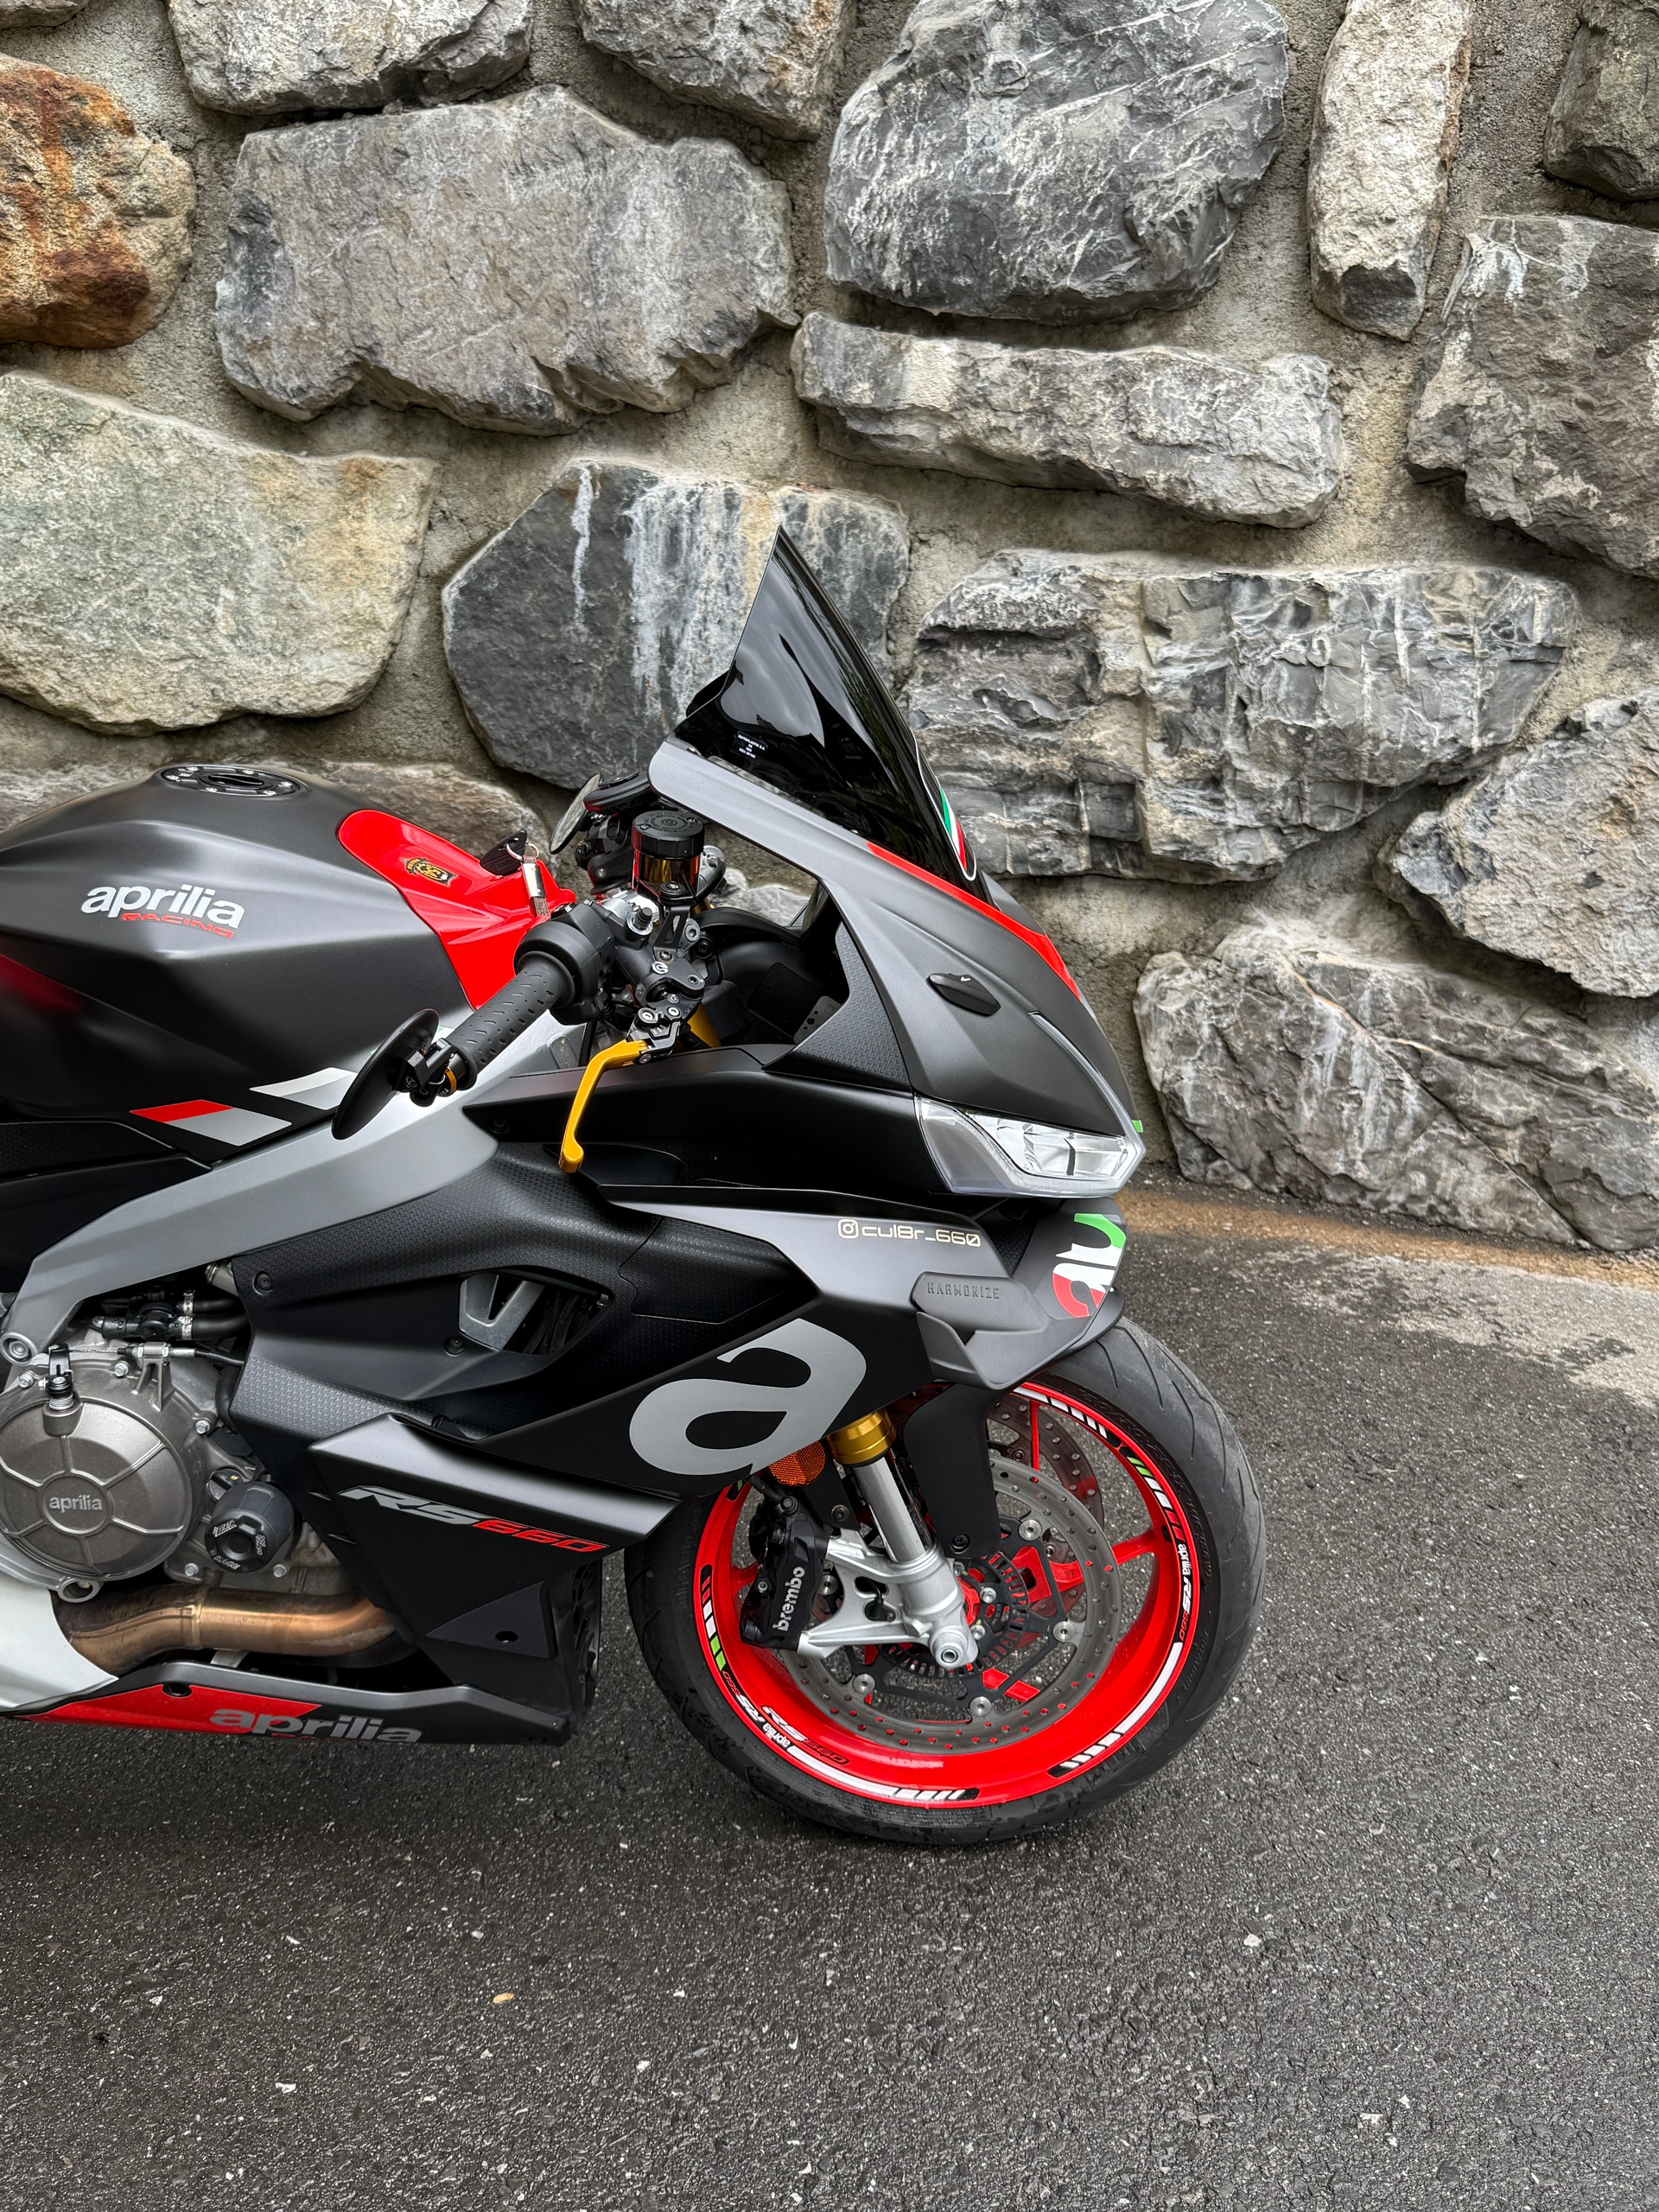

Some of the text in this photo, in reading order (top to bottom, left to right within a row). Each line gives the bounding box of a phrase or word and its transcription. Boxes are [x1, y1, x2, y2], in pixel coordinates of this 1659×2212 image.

[81, 884, 245, 929] aprilia
[121, 912, 235, 940] RACING
[927, 1281, 1000, 1300] HARMONIZE
[49, 1494, 103, 1513] aprilia
[1178, 1543, 1192, 1576] aprilia
[772, 1567, 805, 1631] brembo
[209, 1708, 423, 1743] aprilia
[762, 1723, 791, 1748] aprilia
